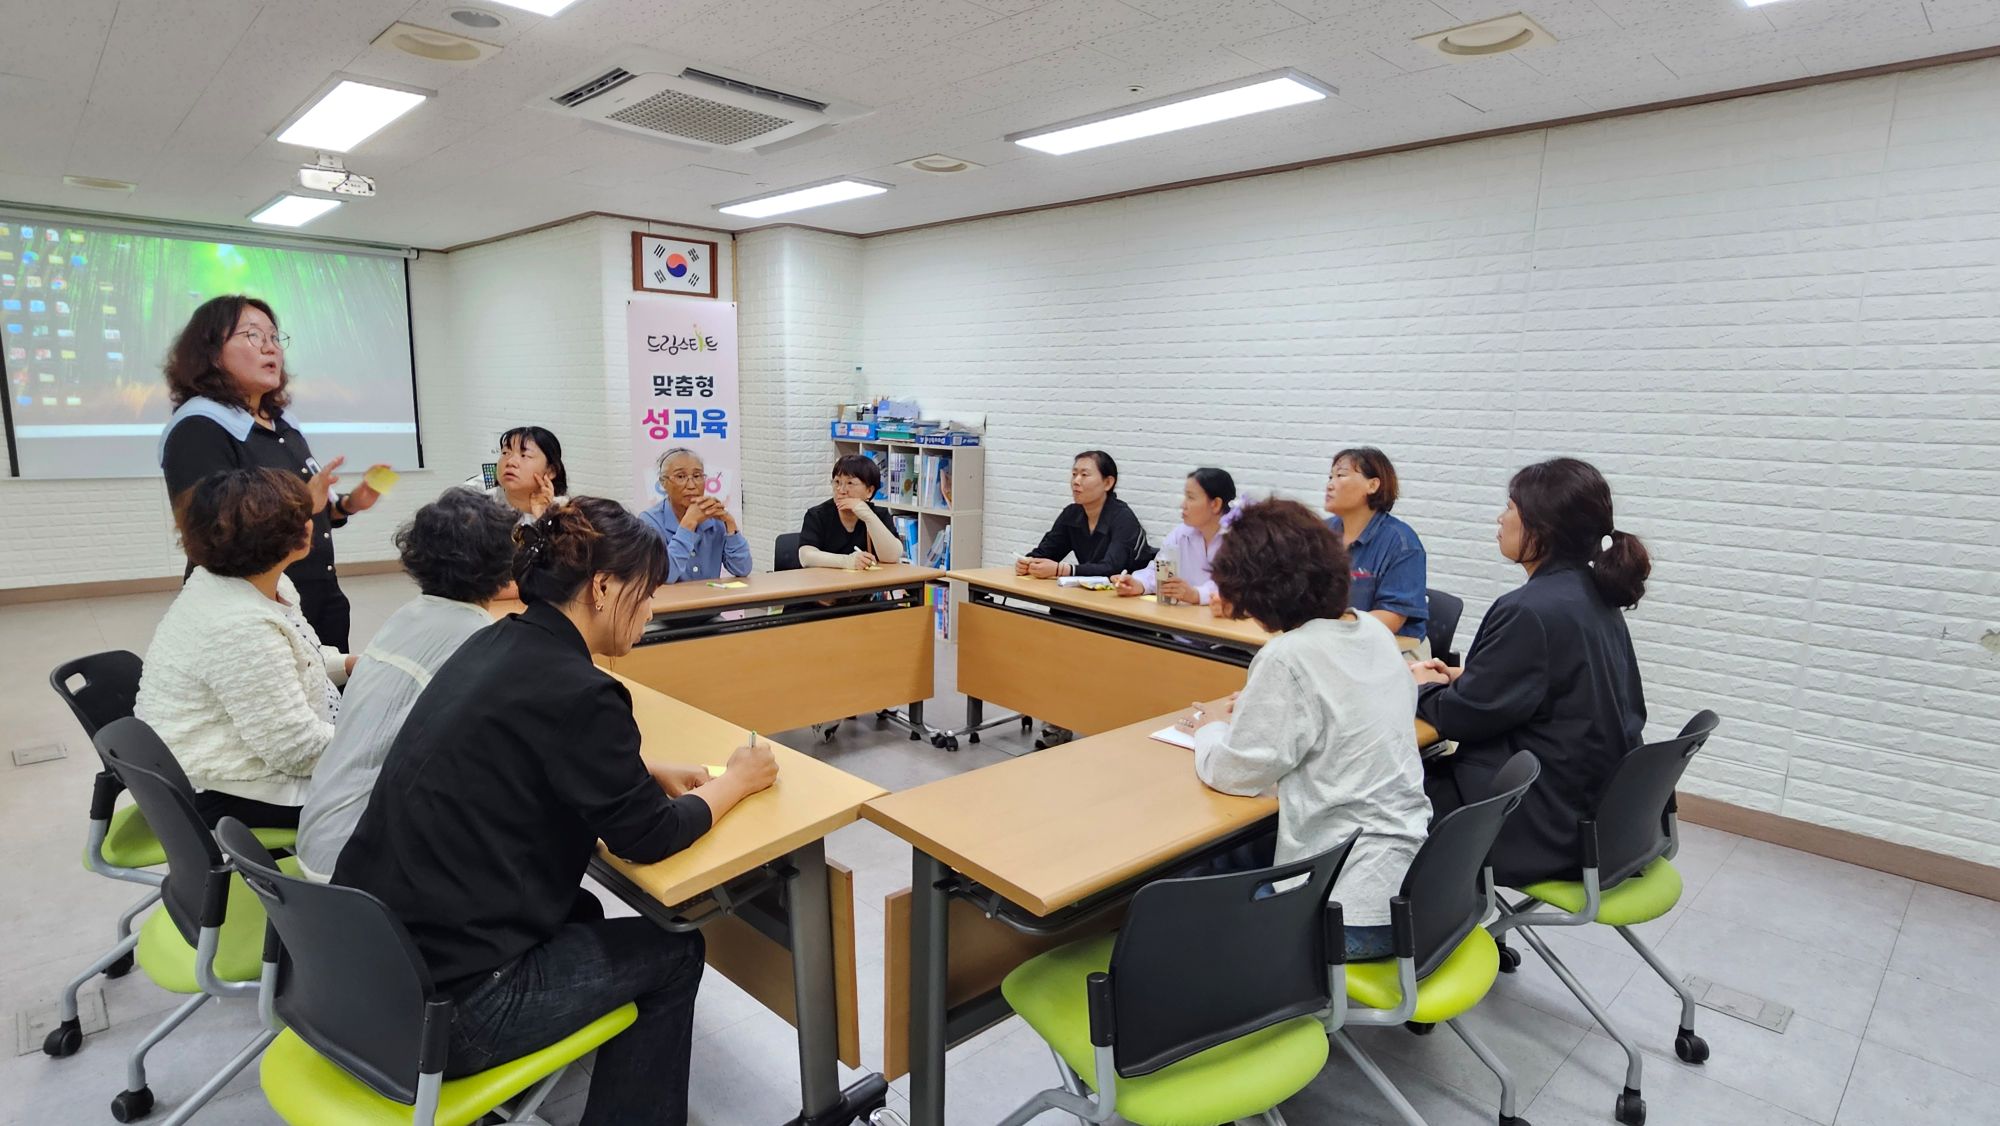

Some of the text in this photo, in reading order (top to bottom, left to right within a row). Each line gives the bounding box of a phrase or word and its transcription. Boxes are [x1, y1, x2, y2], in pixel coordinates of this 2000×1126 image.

[647, 332, 718, 355] 드림스타트
[653, 375, 714, 398] 맞춤형
[642, 408, 728, 440] 성교육
